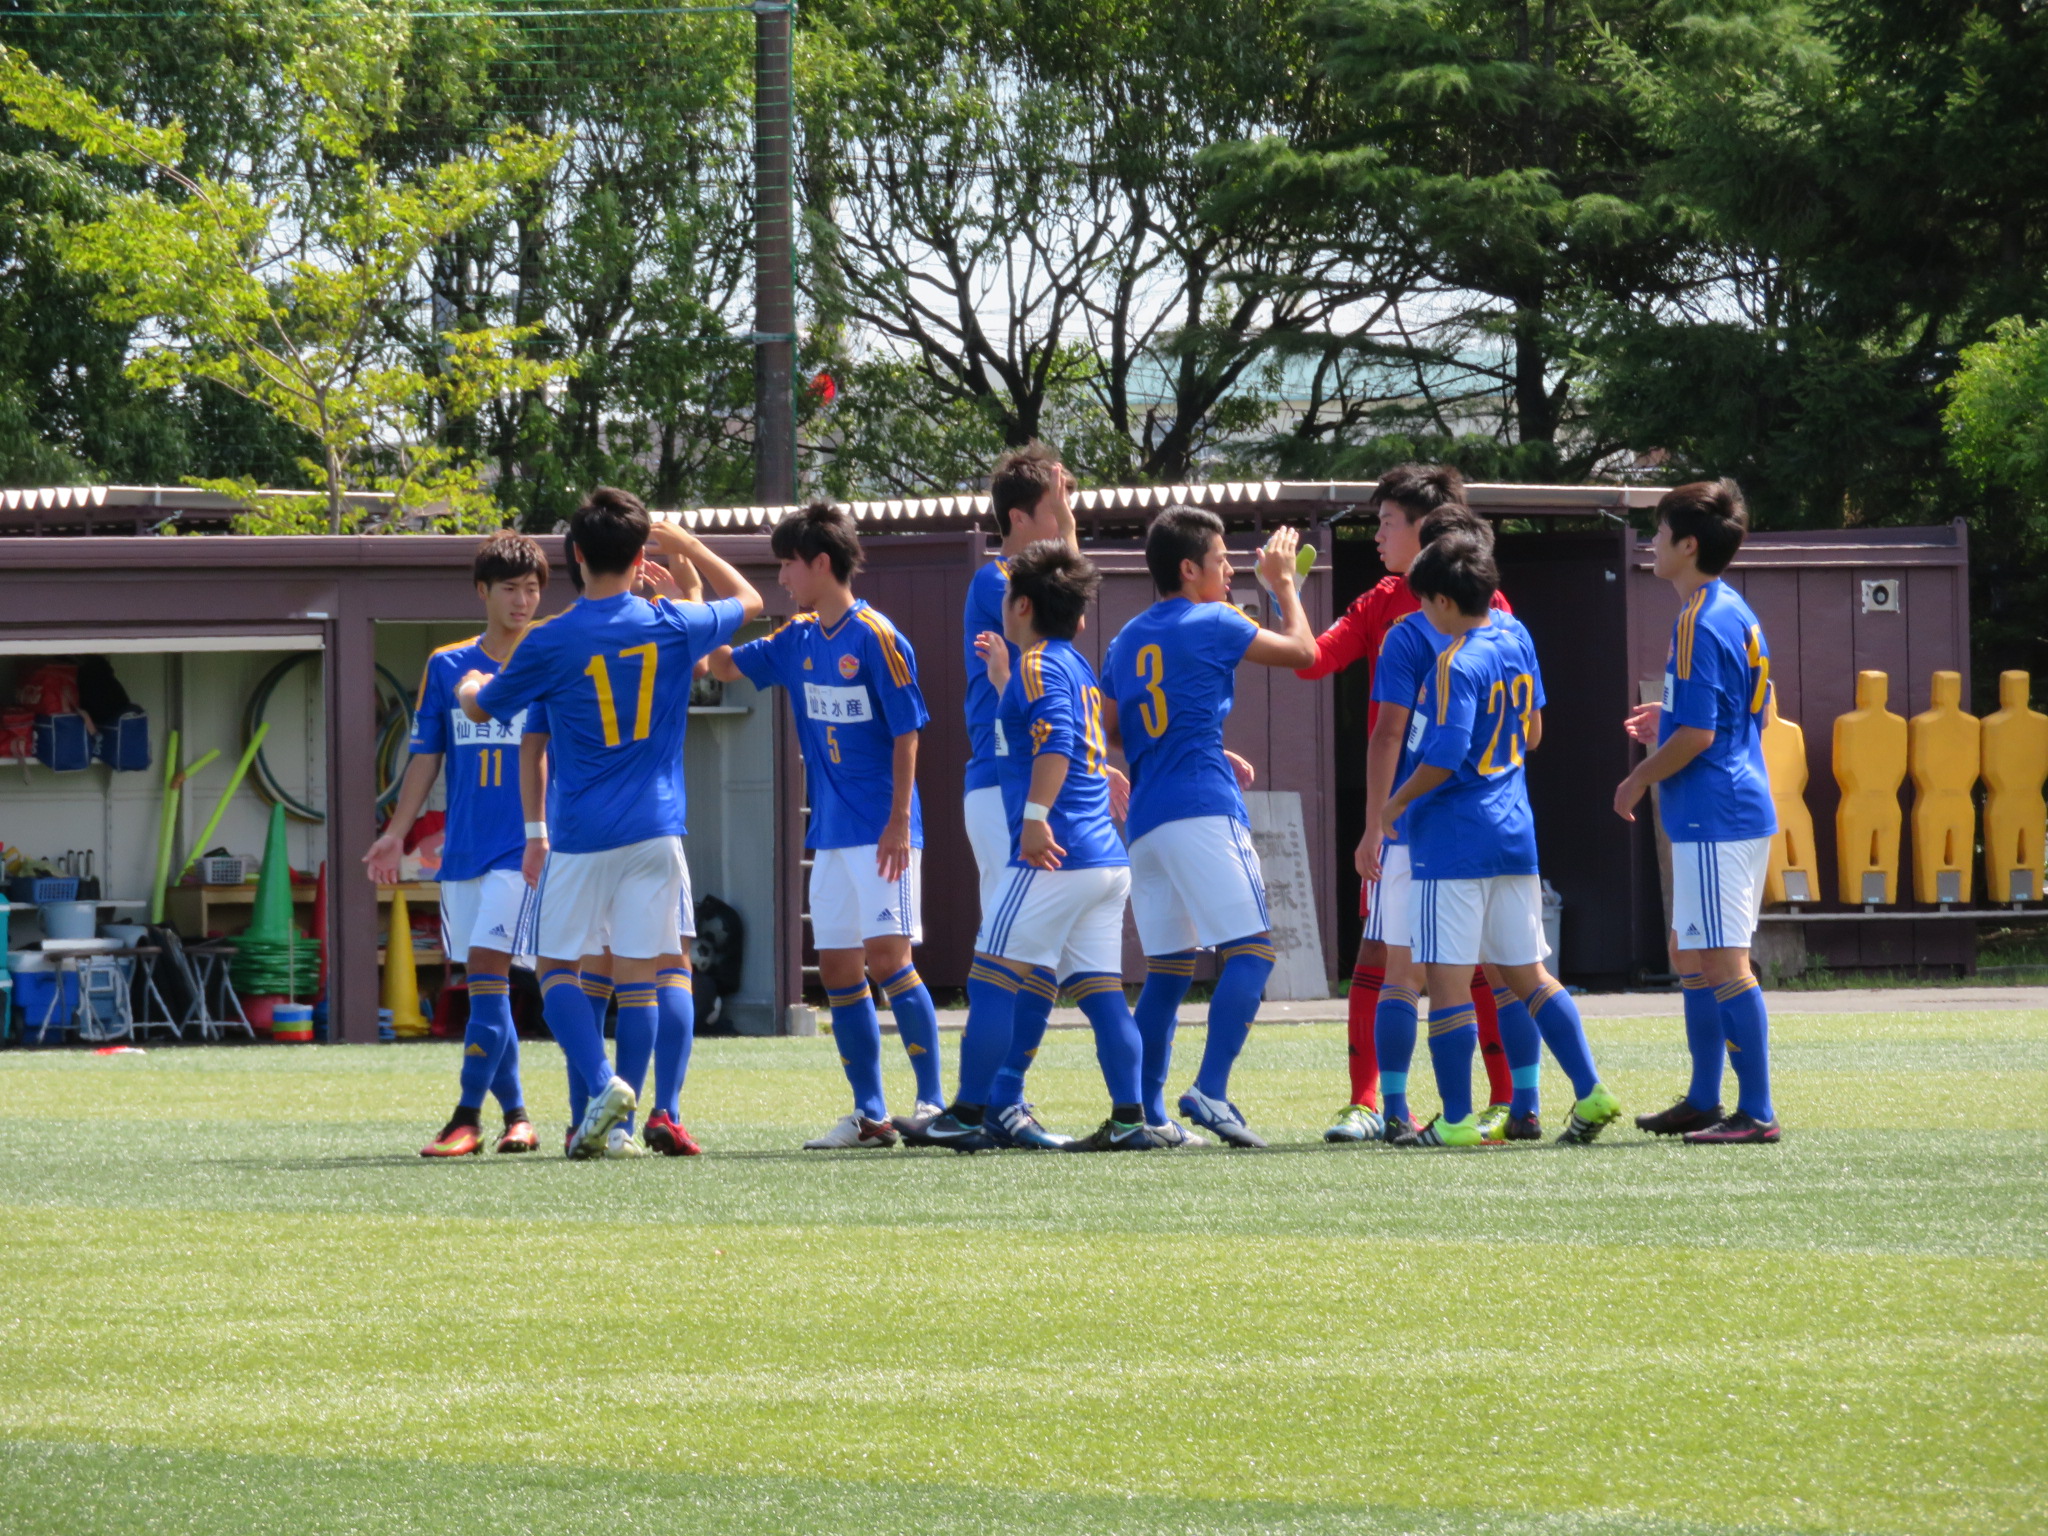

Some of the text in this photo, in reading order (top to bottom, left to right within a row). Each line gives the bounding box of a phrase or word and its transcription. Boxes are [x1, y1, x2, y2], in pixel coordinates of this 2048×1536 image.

[584, 641, 658, 748] 17
[1136, 643, 1168, 738] 3
[456, 720, 526, 740] 仙台水
[826, 725, 841, 764] 5
[1477, 673, 1533, 776] 23
[478, 748, 502, 788] 11
